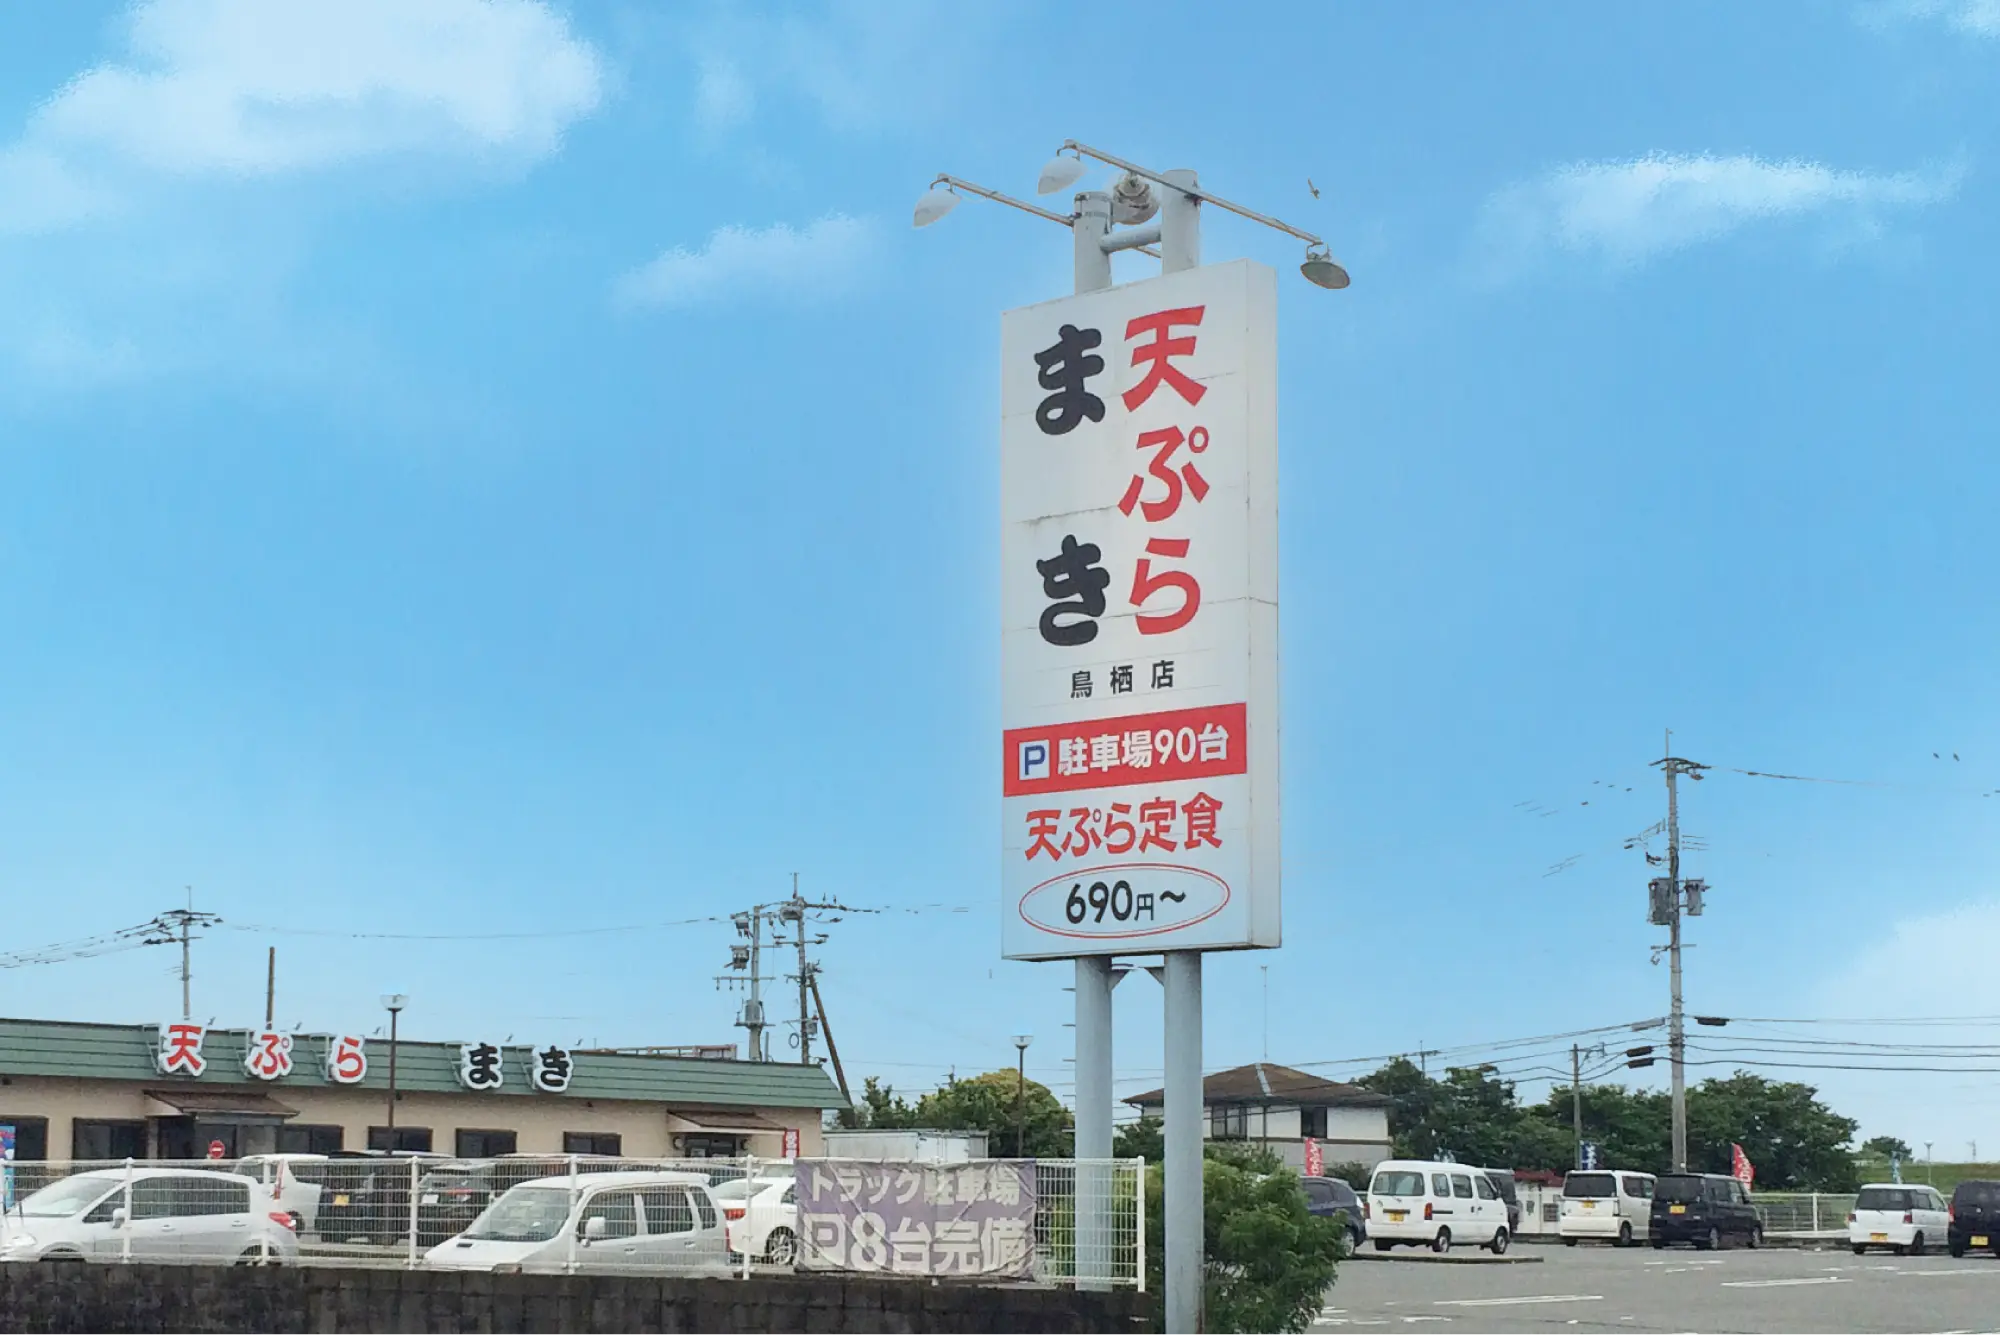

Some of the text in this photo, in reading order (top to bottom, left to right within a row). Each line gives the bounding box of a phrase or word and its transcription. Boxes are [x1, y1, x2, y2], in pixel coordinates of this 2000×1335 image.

[1034, 324, 1110, 646] まき
[1118, 305, 1209, 635] 天ぷら
[1070, 660, 1174, 698] 鳥栖店
[1057, 723, 1228, 776] 駐車場90台
[1024, 792, 1223, 861] 天ぷら定食
